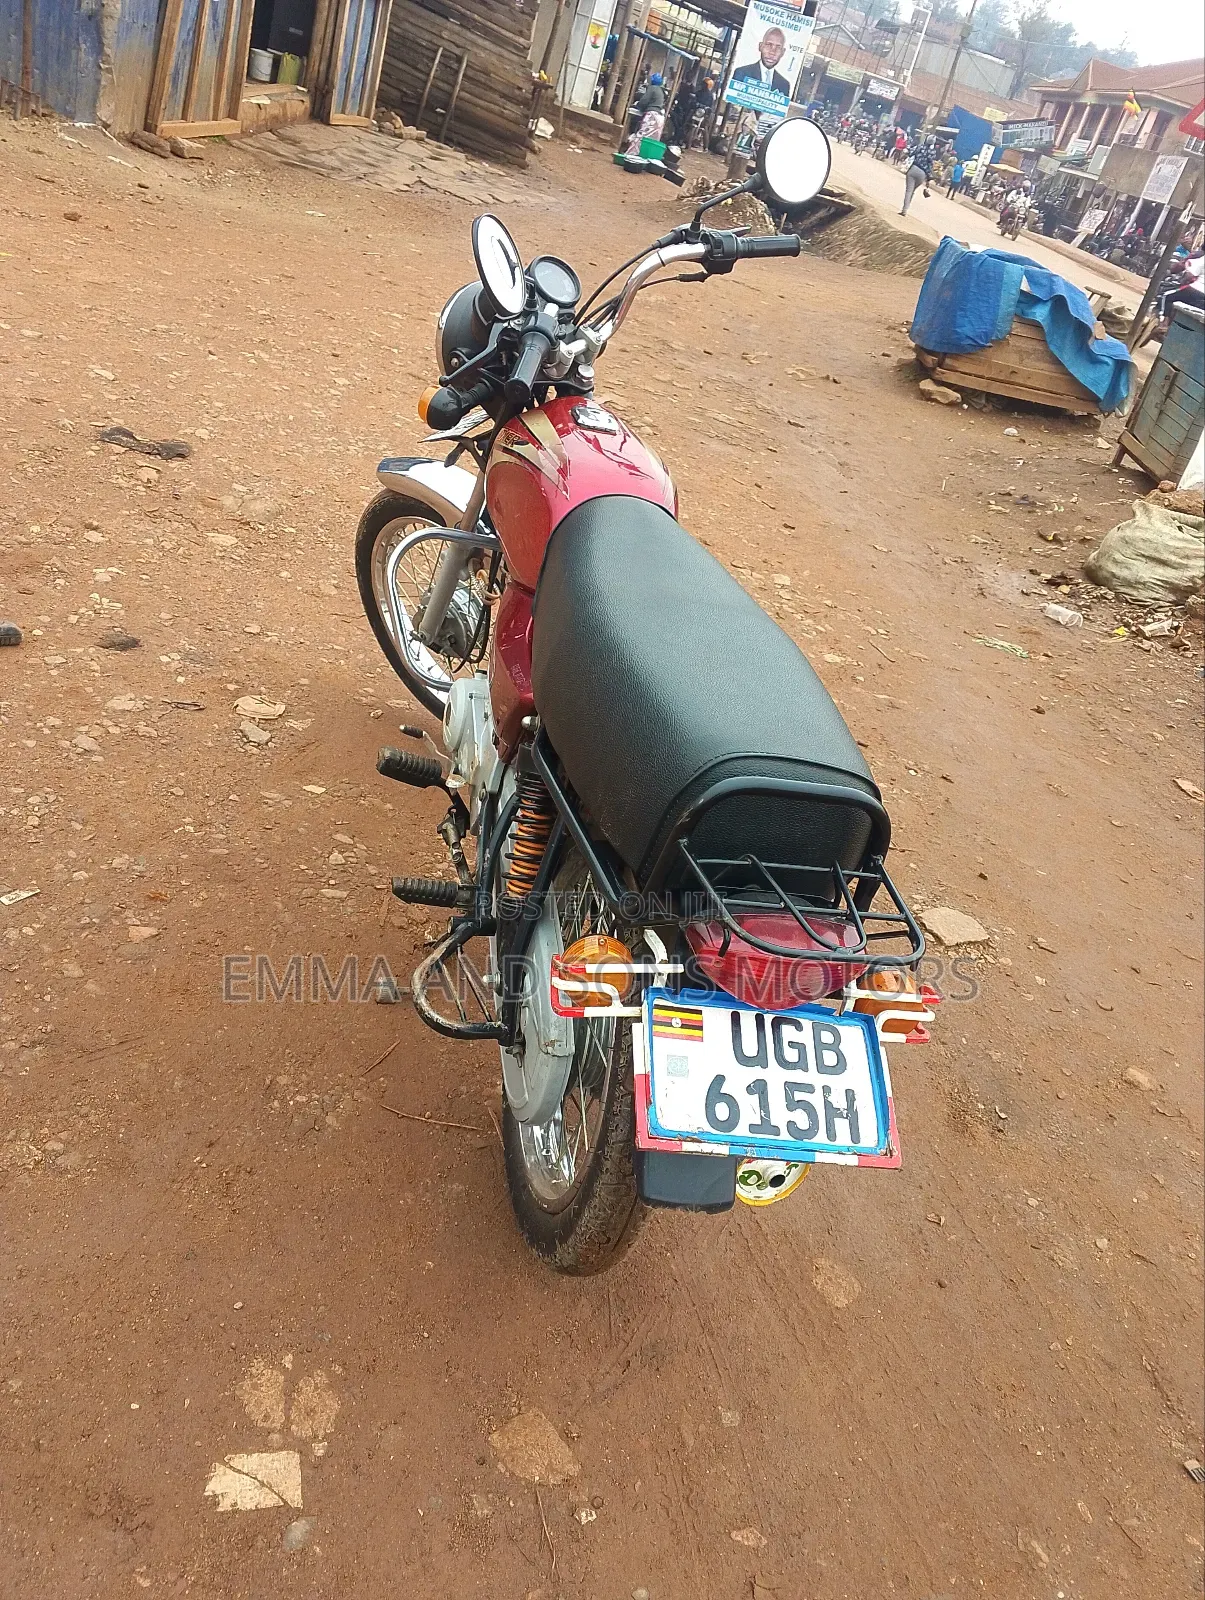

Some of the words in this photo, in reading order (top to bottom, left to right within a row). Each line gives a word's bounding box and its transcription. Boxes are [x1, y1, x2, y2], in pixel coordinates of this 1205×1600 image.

[753, 2, 786, 19] MUSOKE
[786, 13, 813, 27] HAMISI
[760, 14, 802, 32] WALUSIMBI
[789, 43, 804, 54] VOTE
[730, 1010, 848, 1076] UGB
[704, 1073, 861, 1145] 615H
